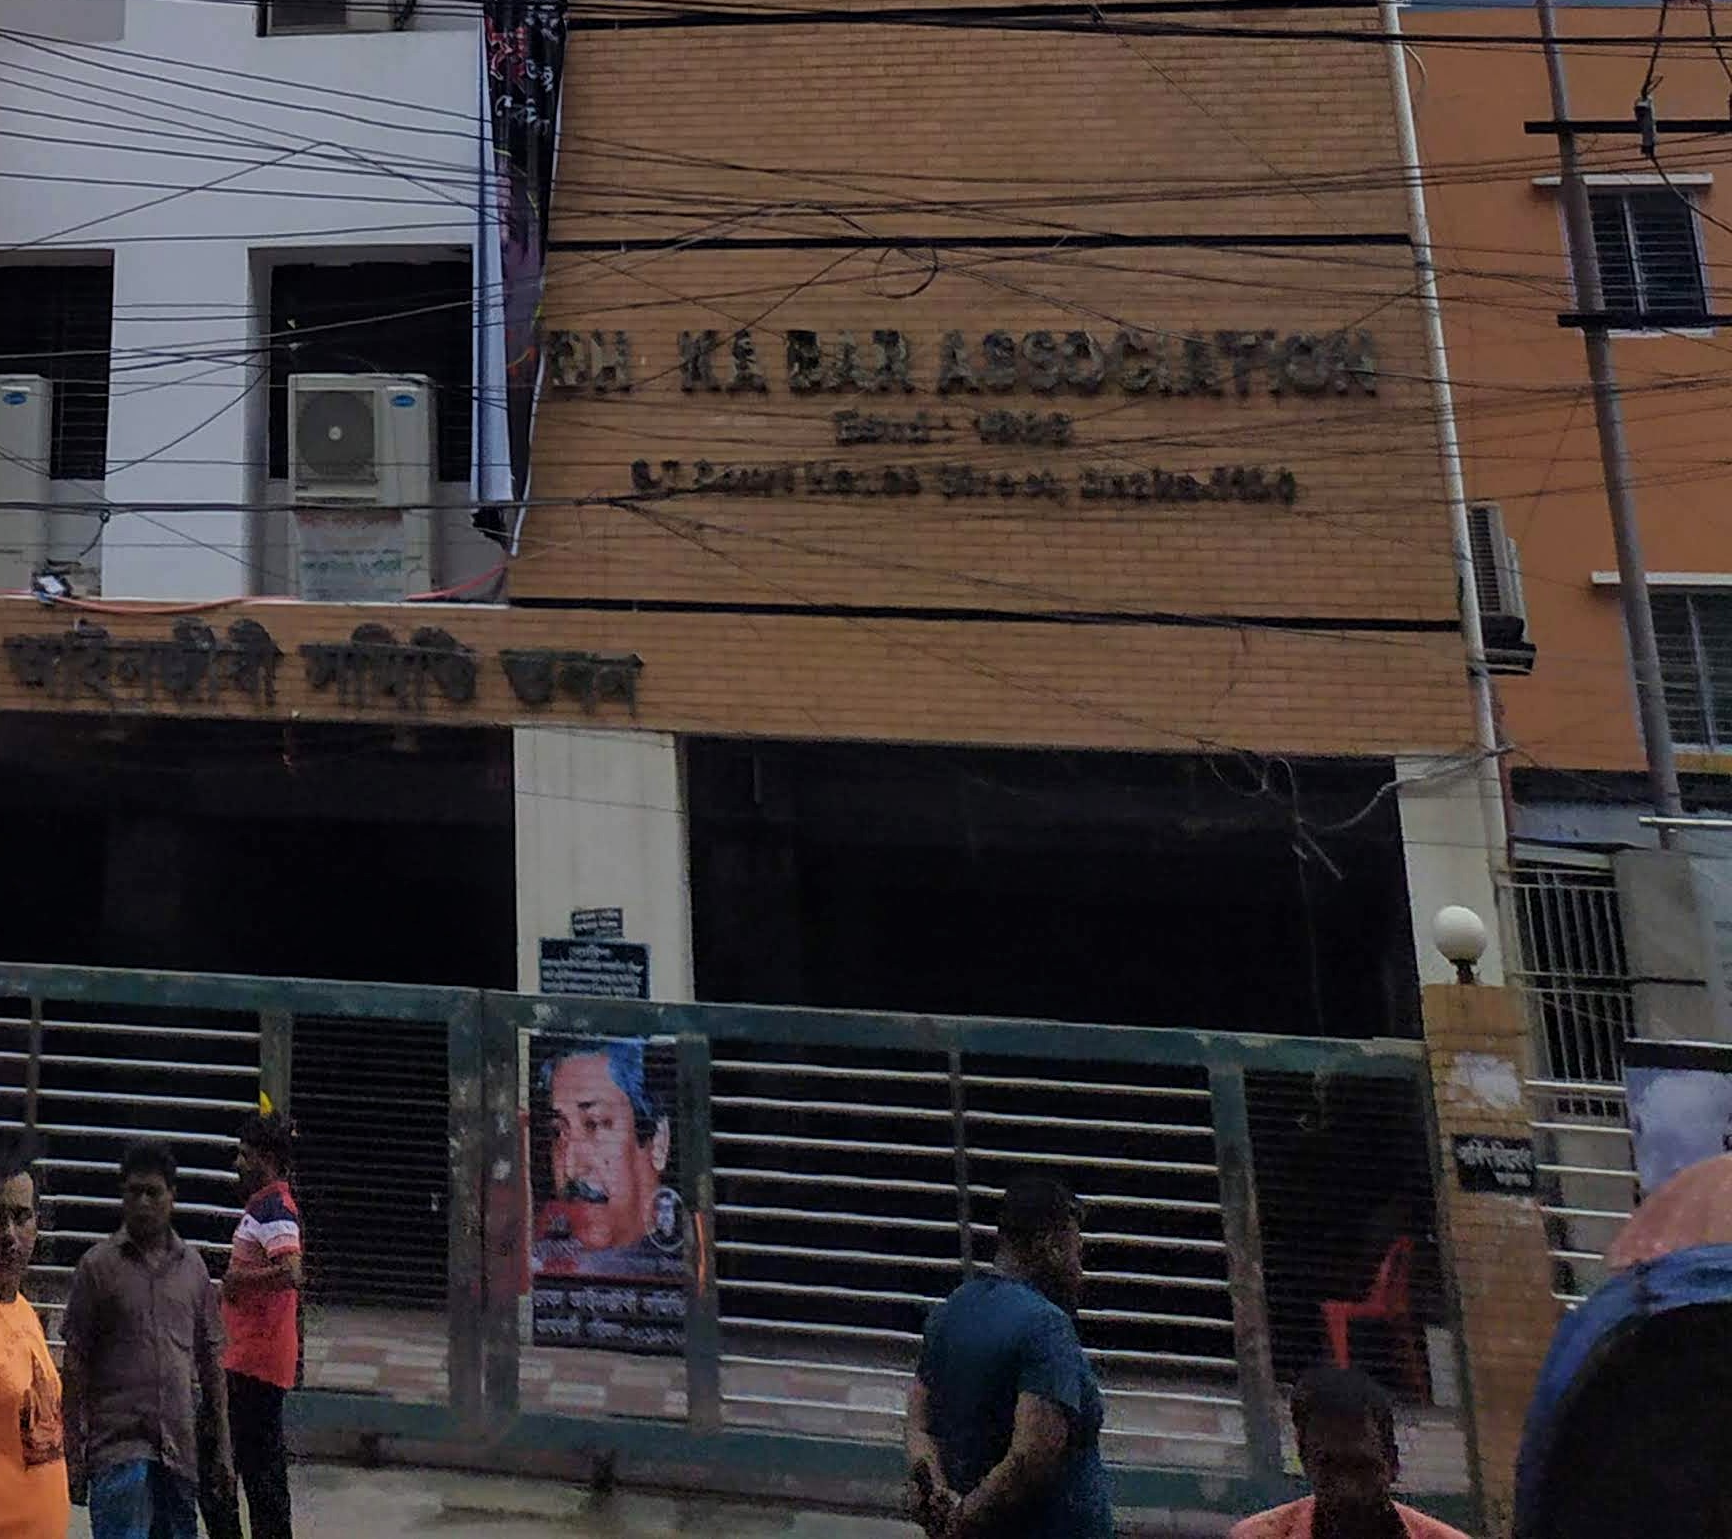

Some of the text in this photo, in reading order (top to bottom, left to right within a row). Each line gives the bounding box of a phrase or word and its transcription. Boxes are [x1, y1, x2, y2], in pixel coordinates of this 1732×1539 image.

[786, 329, 913, 394] BAR
[936, 328, 1377, 397] ASSOCIATION
[4, 616, 283, 707] আইনজীবী
